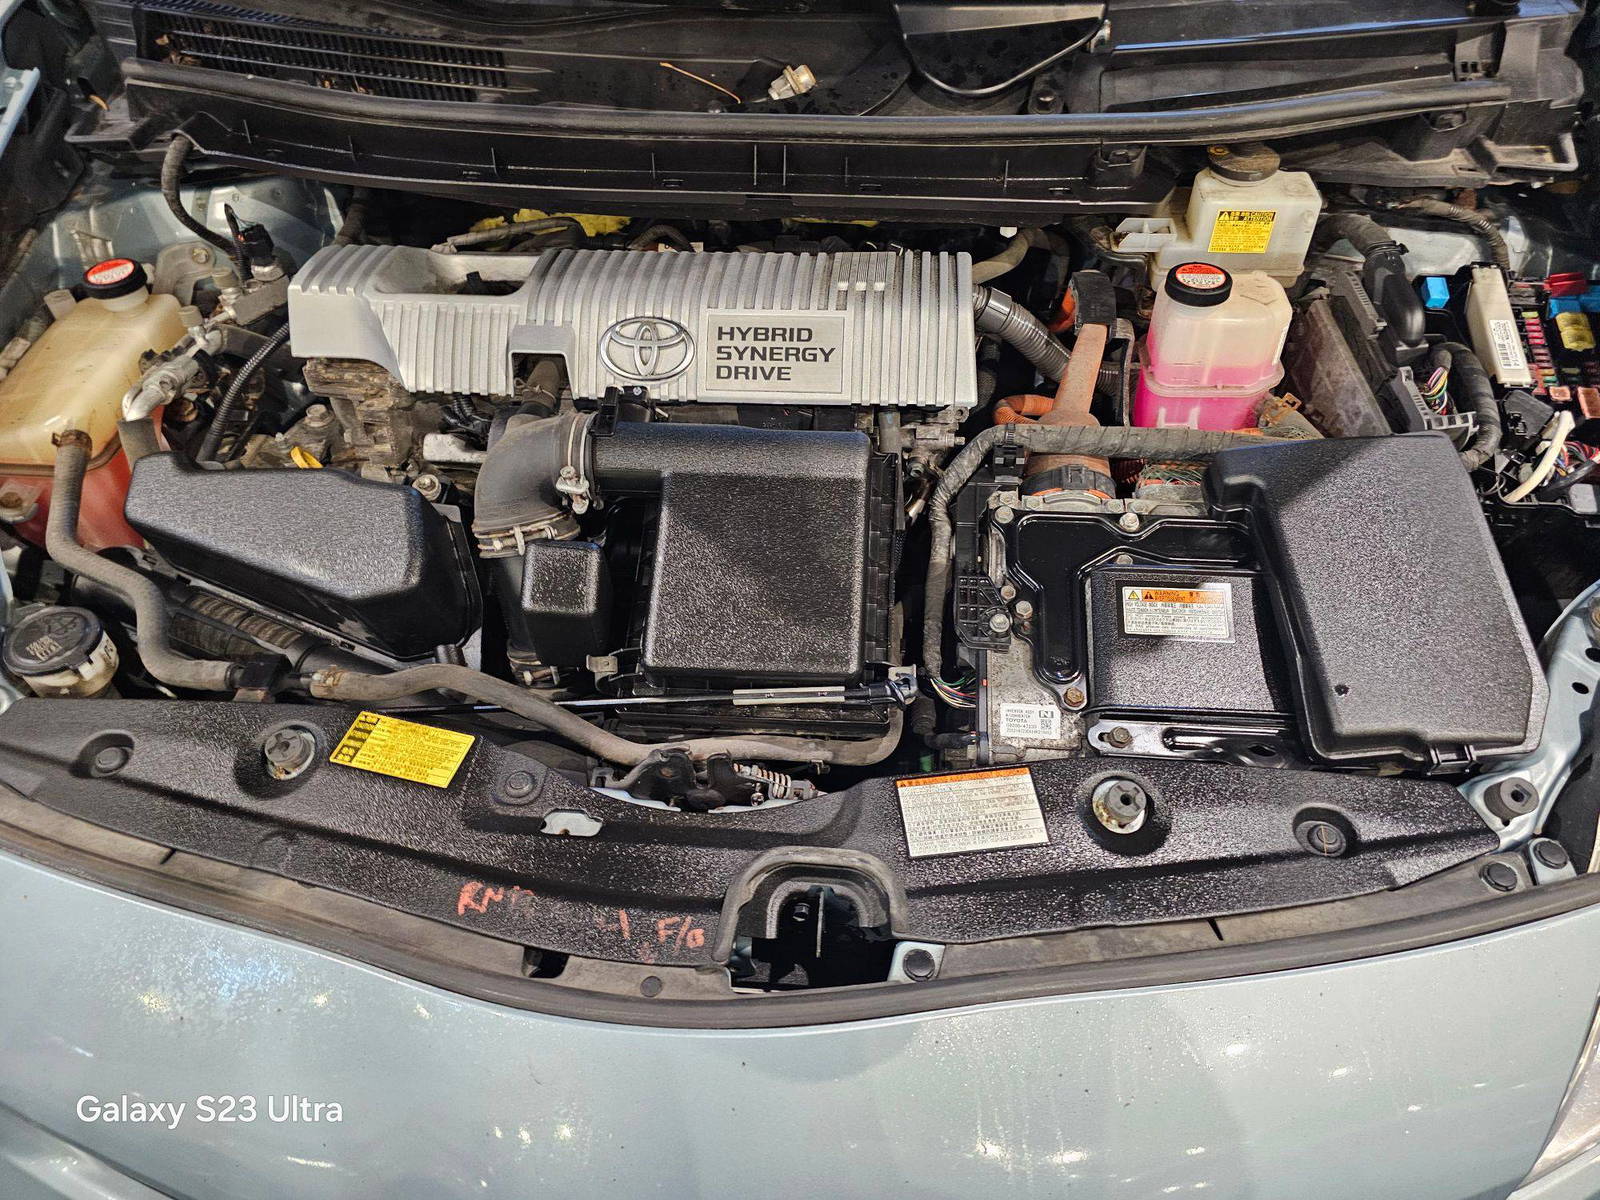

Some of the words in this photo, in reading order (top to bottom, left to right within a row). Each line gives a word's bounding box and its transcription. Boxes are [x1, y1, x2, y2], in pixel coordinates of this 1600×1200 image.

[717, 326, 813, 342] HYBRID
[716, 346, 836, 362] SYNERGY
[716, 365, 792, 381] DRIVE
